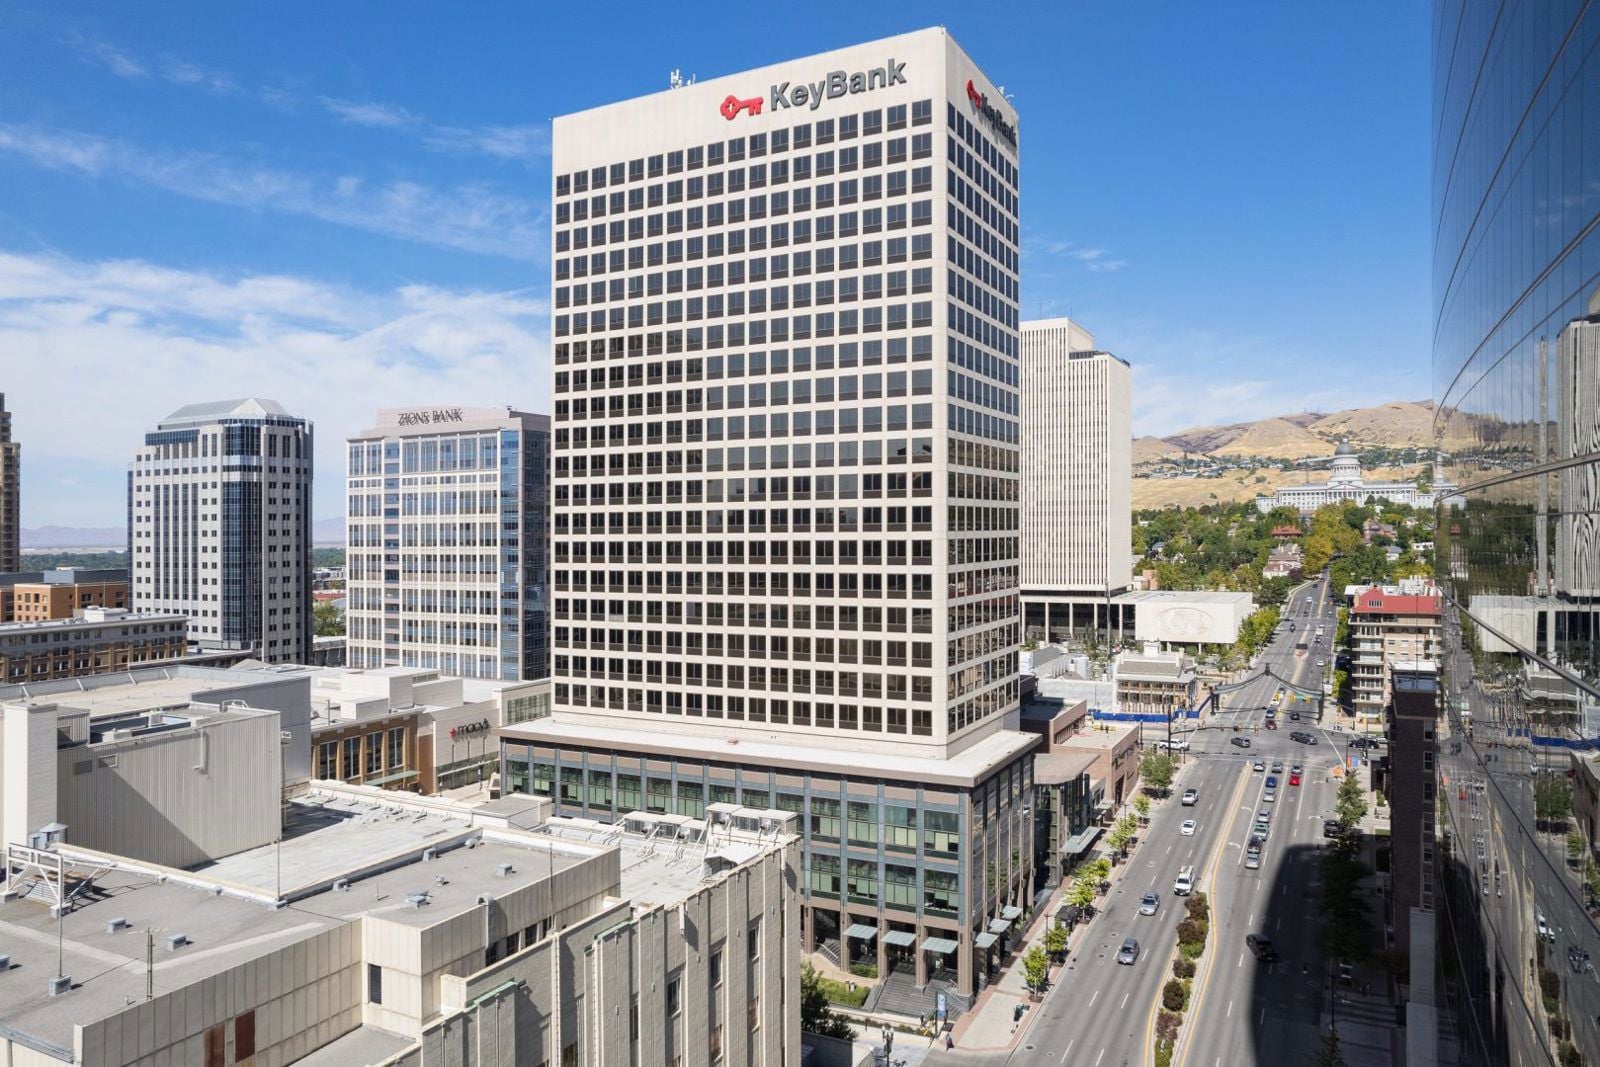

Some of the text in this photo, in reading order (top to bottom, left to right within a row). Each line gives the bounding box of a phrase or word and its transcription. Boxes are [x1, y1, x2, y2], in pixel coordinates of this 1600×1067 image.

[770, 58, 907, 111] KeyBank
[398, 408, 463, 426] ZIONS BANK
